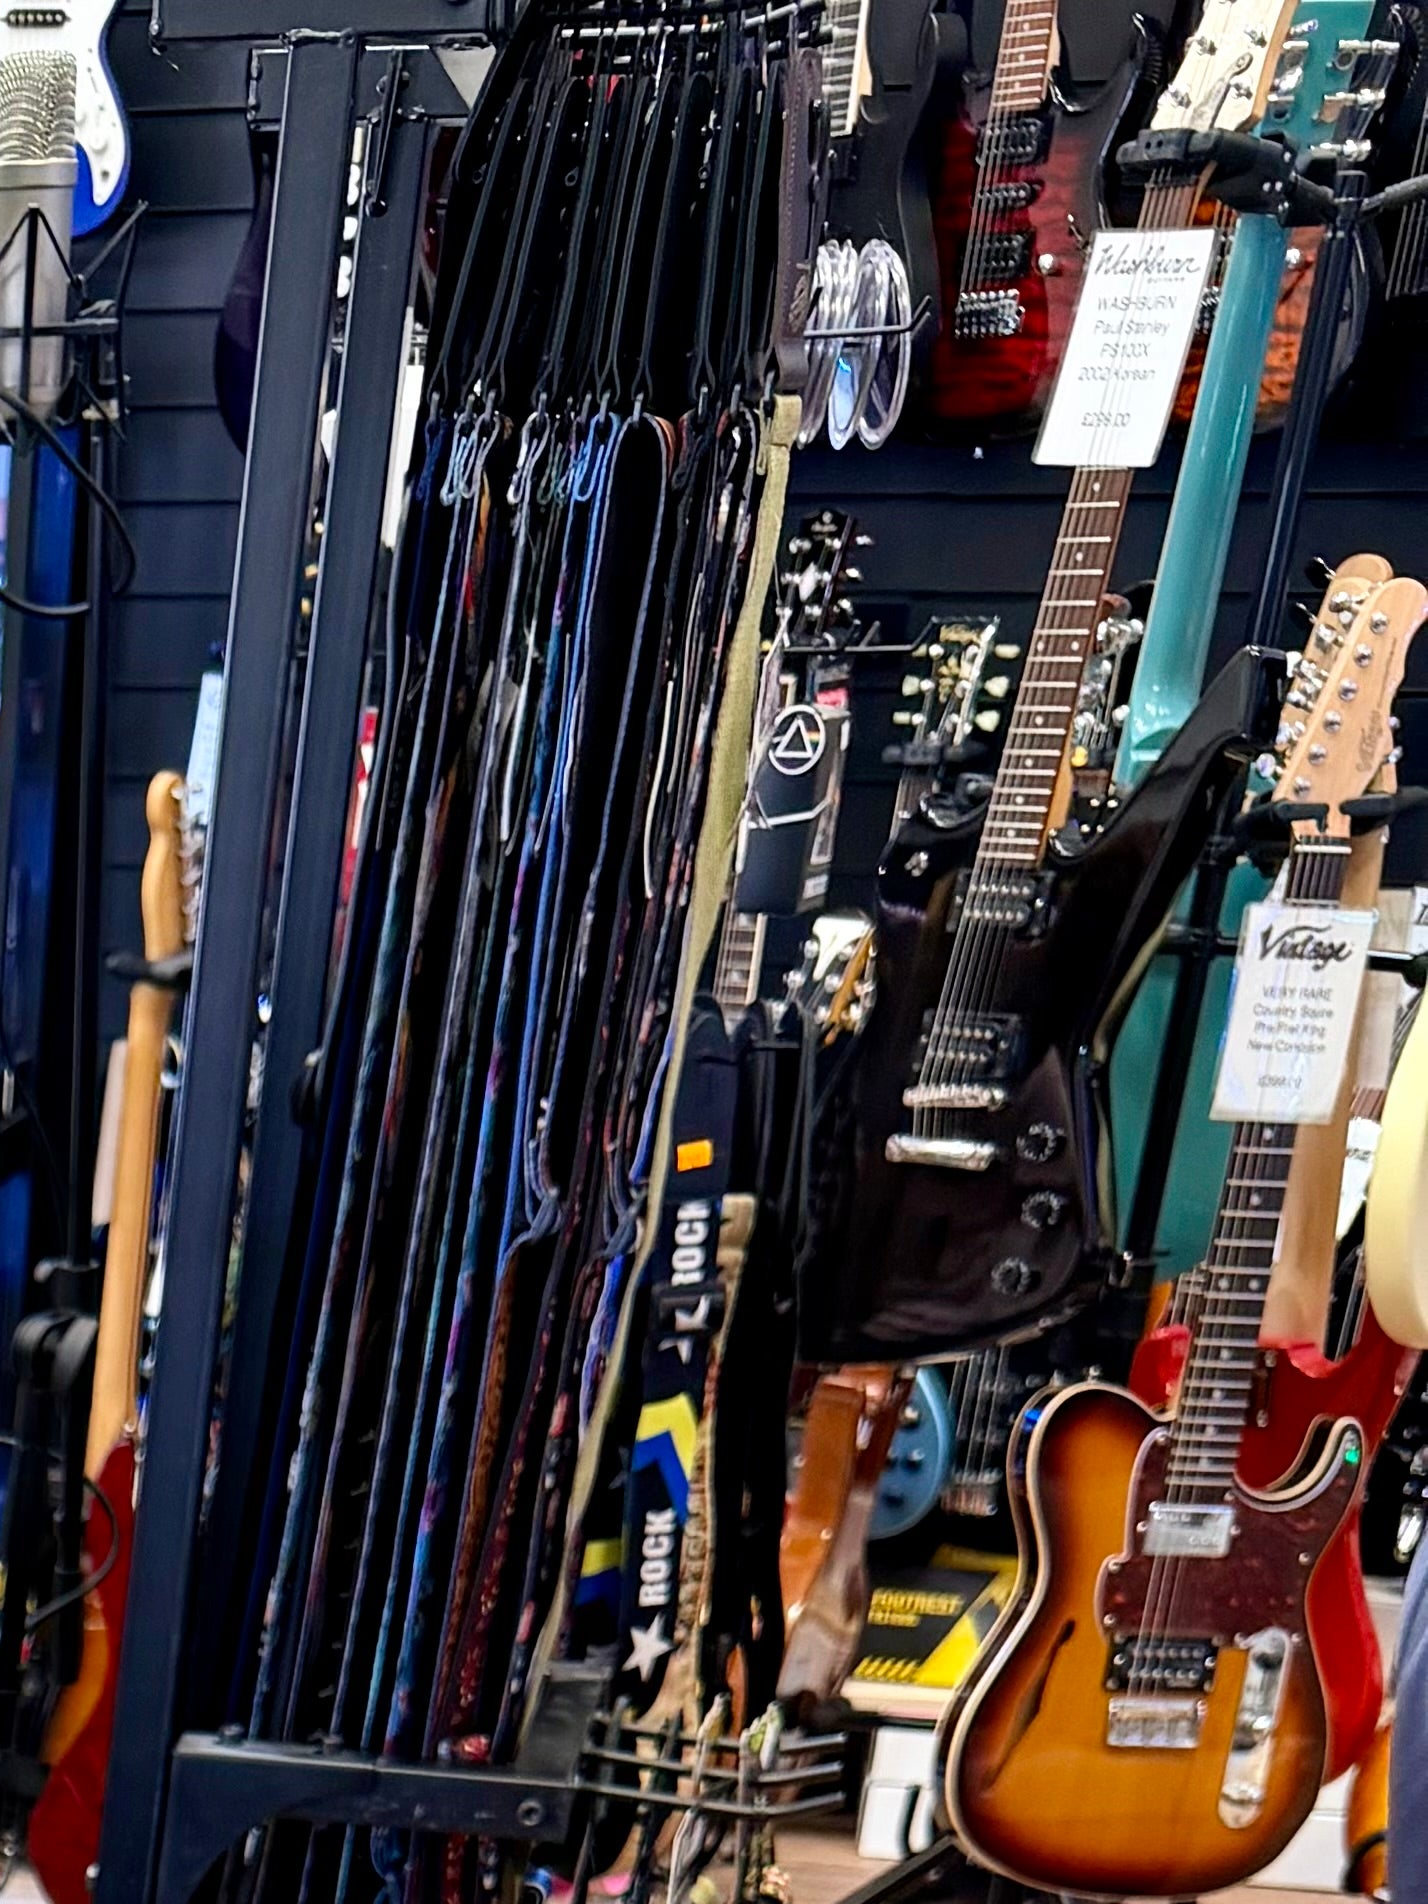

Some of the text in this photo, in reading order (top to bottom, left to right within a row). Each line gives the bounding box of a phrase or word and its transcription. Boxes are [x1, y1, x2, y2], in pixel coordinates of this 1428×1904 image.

[1095, 243, 1201, 276] Washburn
[1259, 924, 1353, 972] Vintage
[639, 1507, 677, 1607] ROCK
